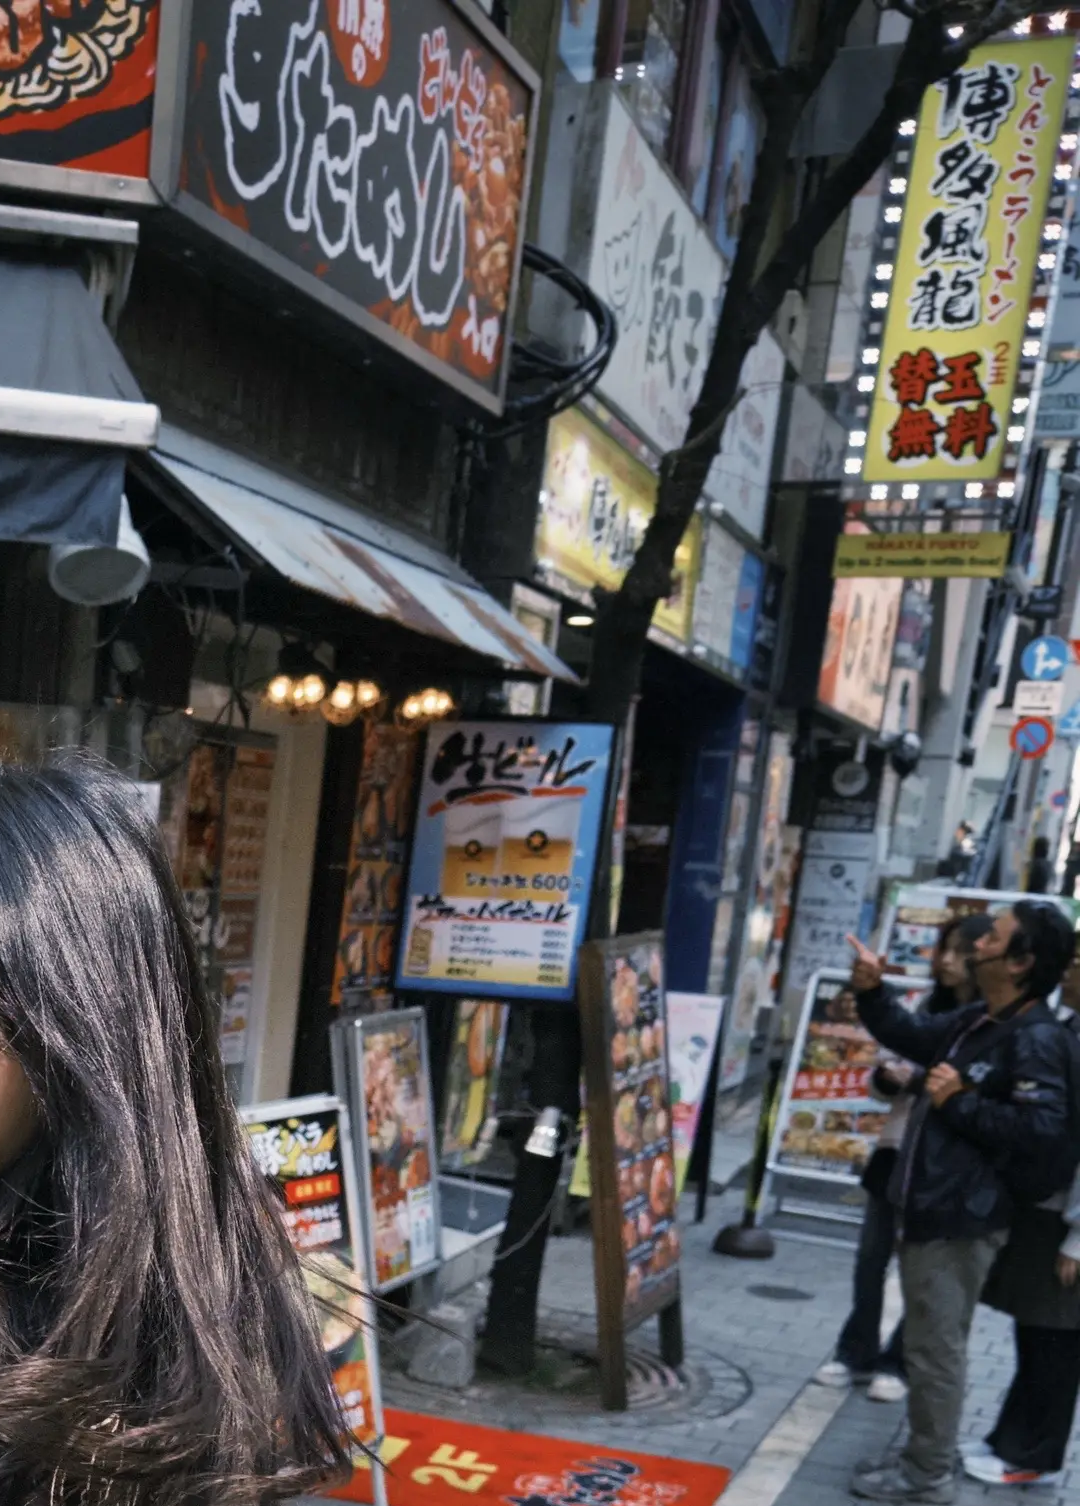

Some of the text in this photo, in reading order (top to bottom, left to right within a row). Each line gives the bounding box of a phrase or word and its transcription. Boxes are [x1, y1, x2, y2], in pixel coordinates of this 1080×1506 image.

[910, 63, 1018, 326] 博多風龍
[988, 65, 1052, 322] とんこつラーメン
[889, 347, 985, 406] 替玉
[887, 402, 998, 462] 無料
[411, 1442, 498, 1493] 2F
